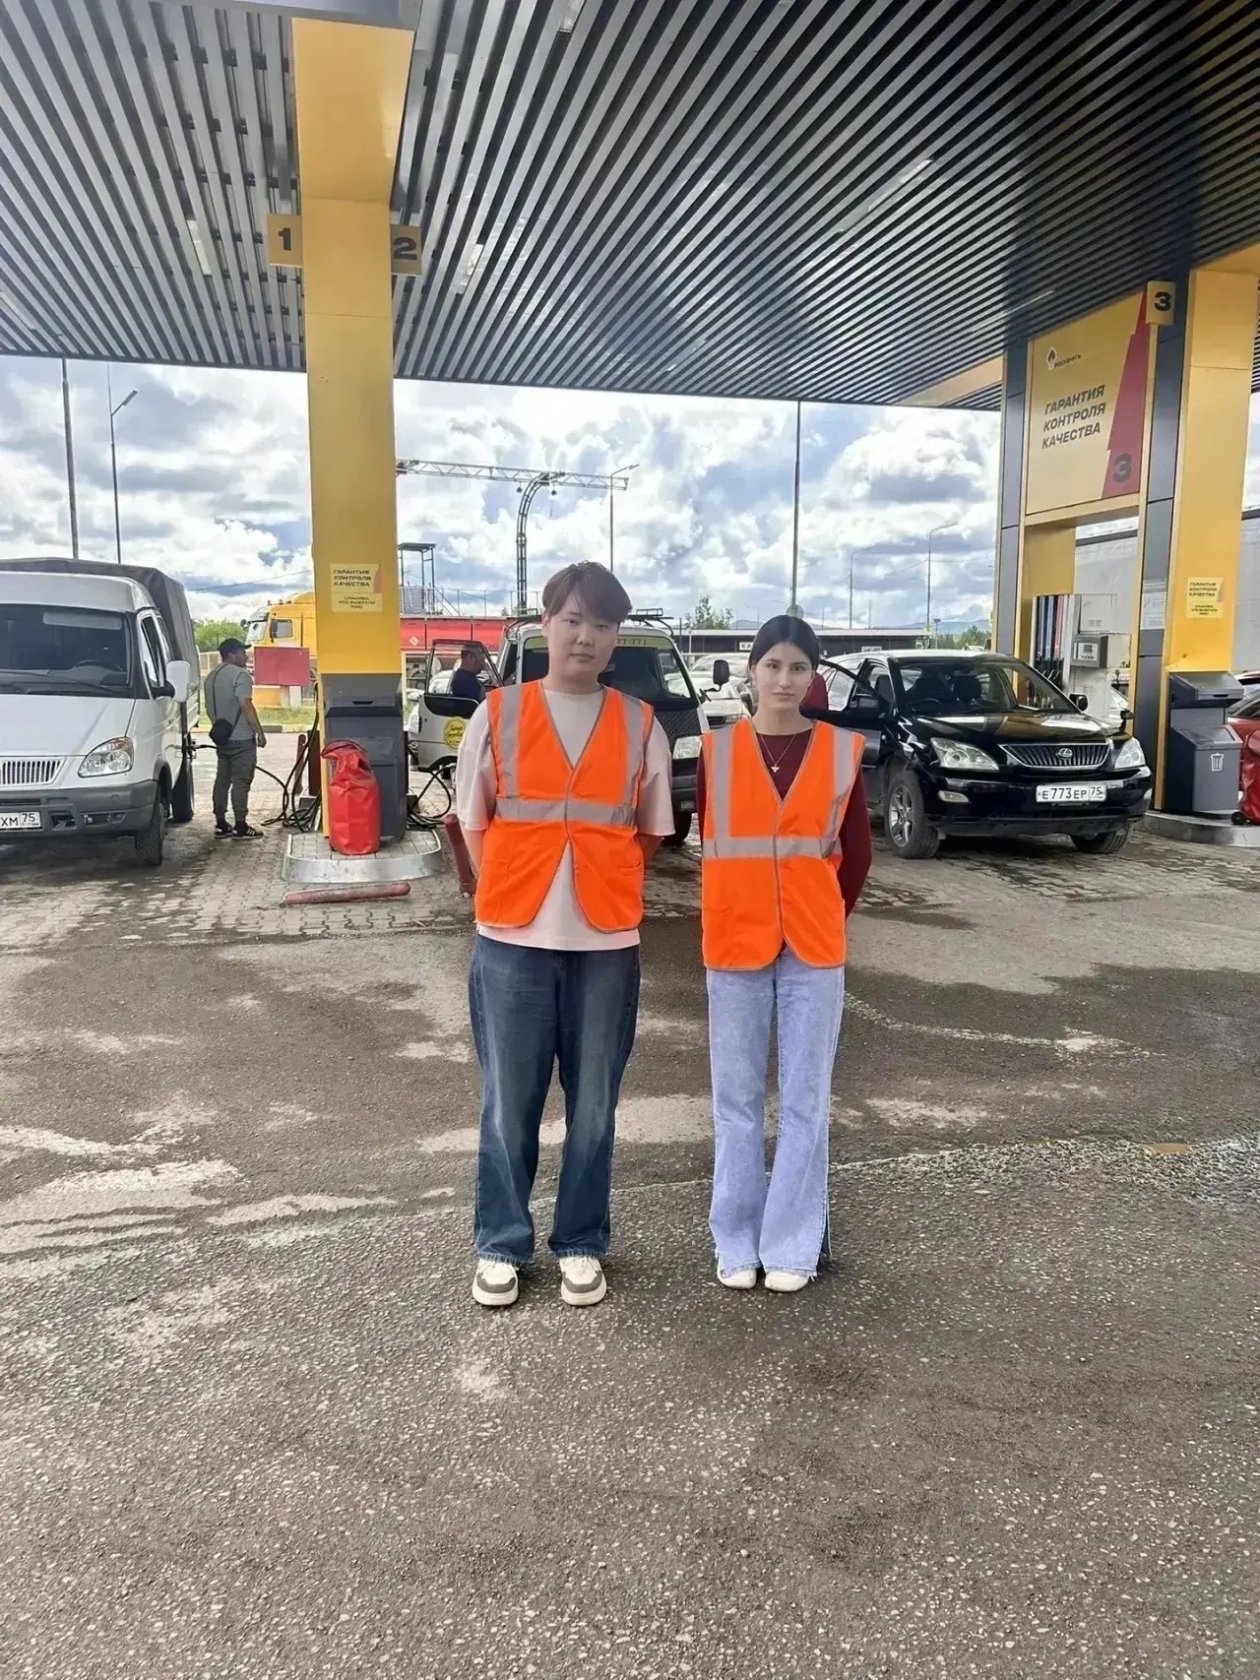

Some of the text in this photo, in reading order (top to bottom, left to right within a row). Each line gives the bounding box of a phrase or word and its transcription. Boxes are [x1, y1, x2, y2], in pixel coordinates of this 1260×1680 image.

[278, 227, 292, 251] 1
[393, 236, 418, 261] 2
[1154, 291, 1171, 312] 3
[1044, 384, 1105, 415] ГАРАНТИЯ
[1043, 402, 1106, 432] КОНТРОЛЯ
[1041, 422, 1101, 449] КАЧЕСТВА
[1114, 453, 1132, 483] 3
[22, 812, 36, 823] 75
